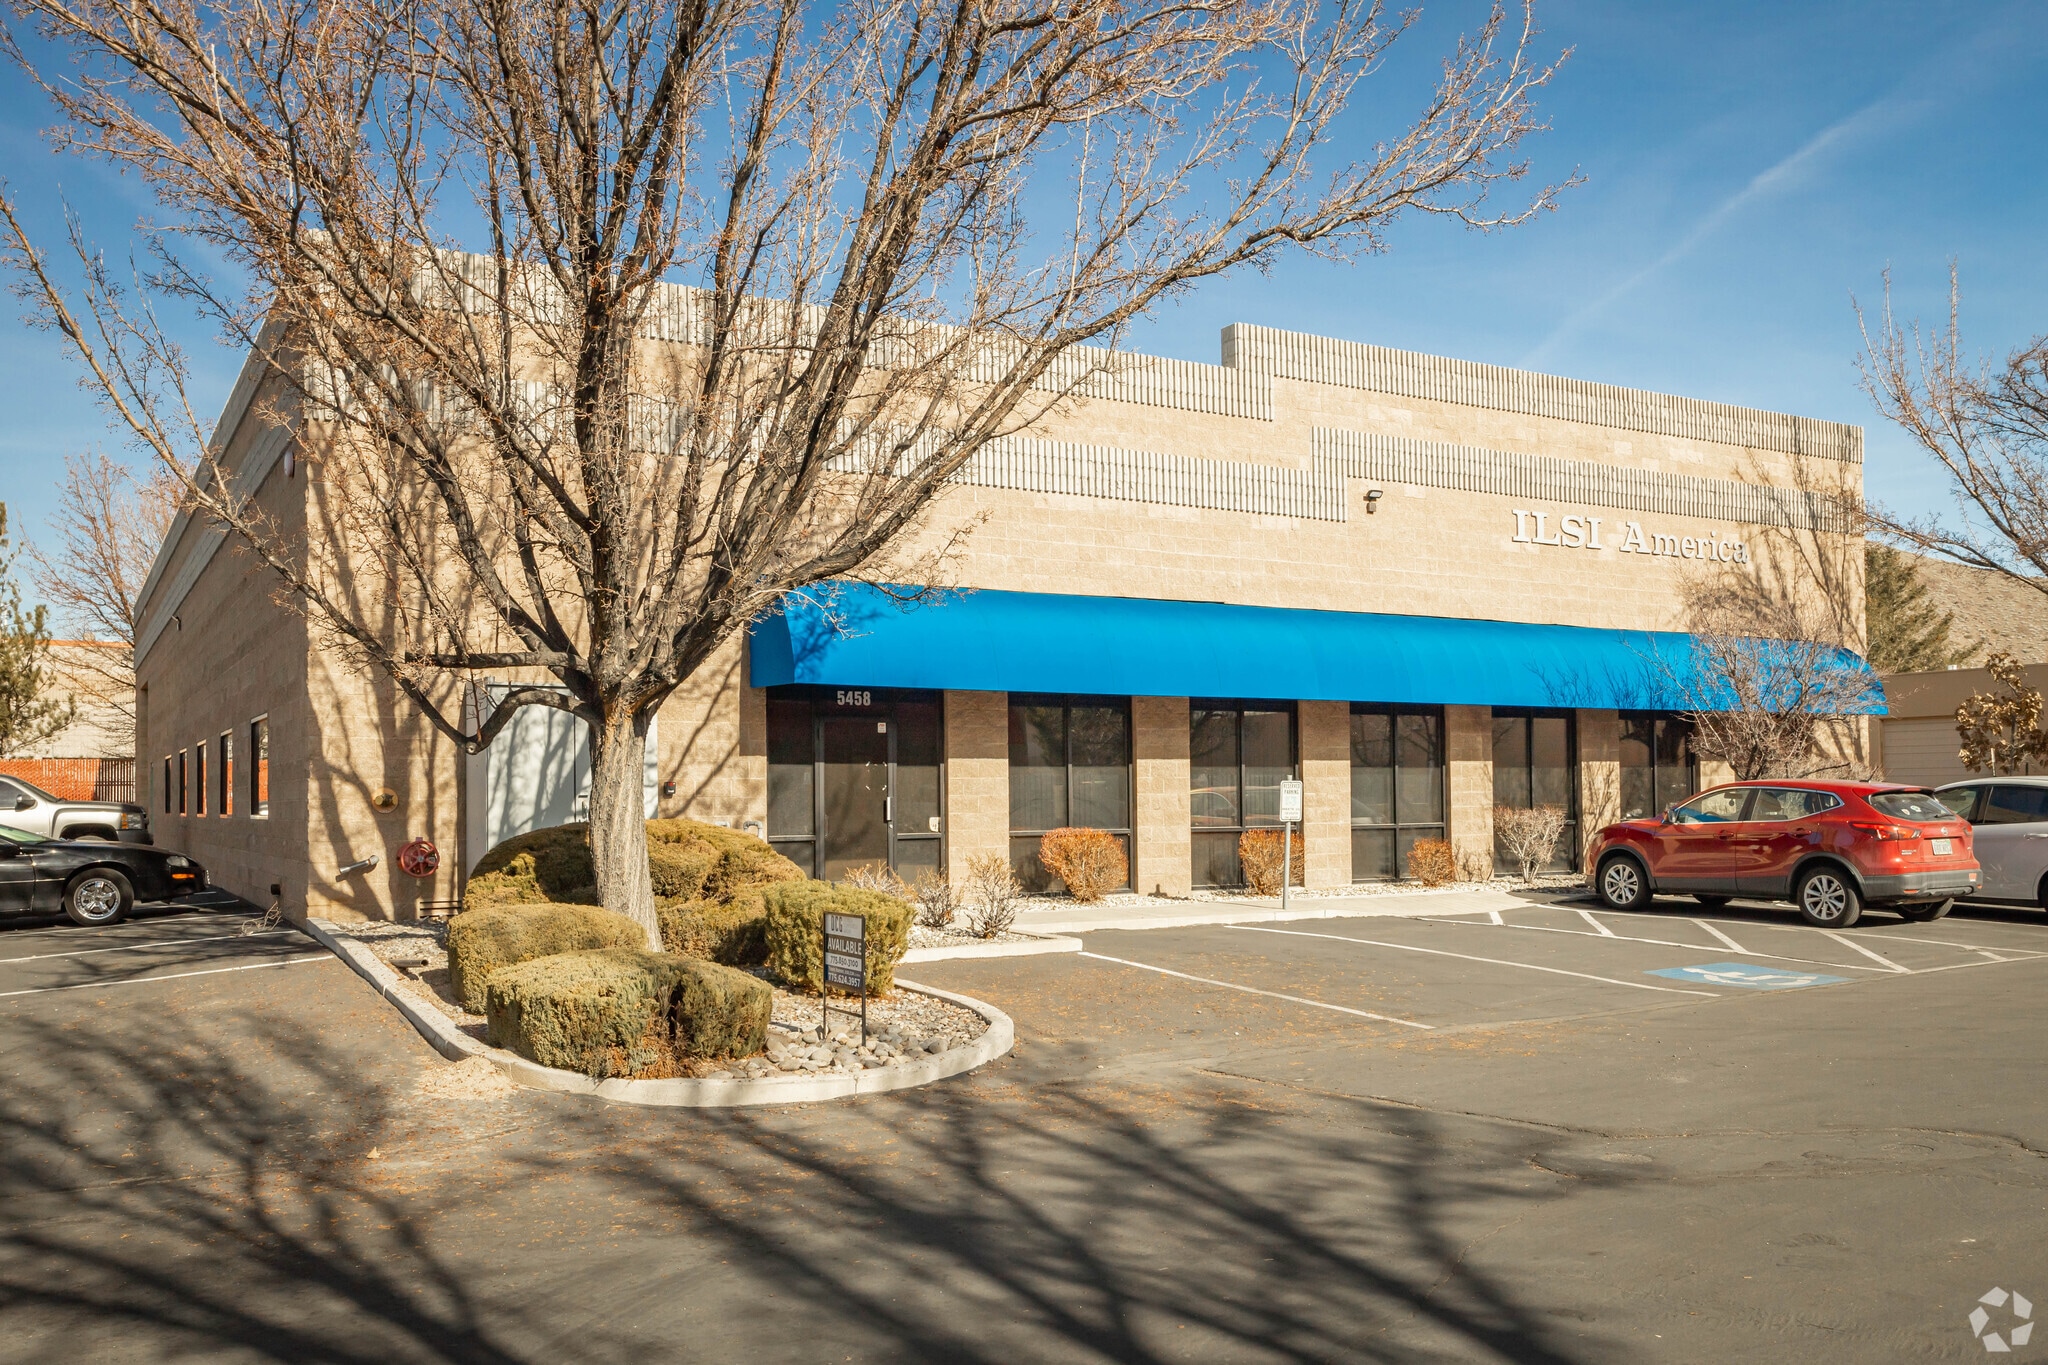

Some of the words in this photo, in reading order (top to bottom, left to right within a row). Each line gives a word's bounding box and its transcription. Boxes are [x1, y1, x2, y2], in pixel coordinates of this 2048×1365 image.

[1511, 508, 1603, 550] ILSI
[1619, 521, 1748, 564] America
[837, 690, 871, 706] 5458
[827, 937, 861, 955] AVAILABLE
[828, 972, 860, 987] 775.624.3957
